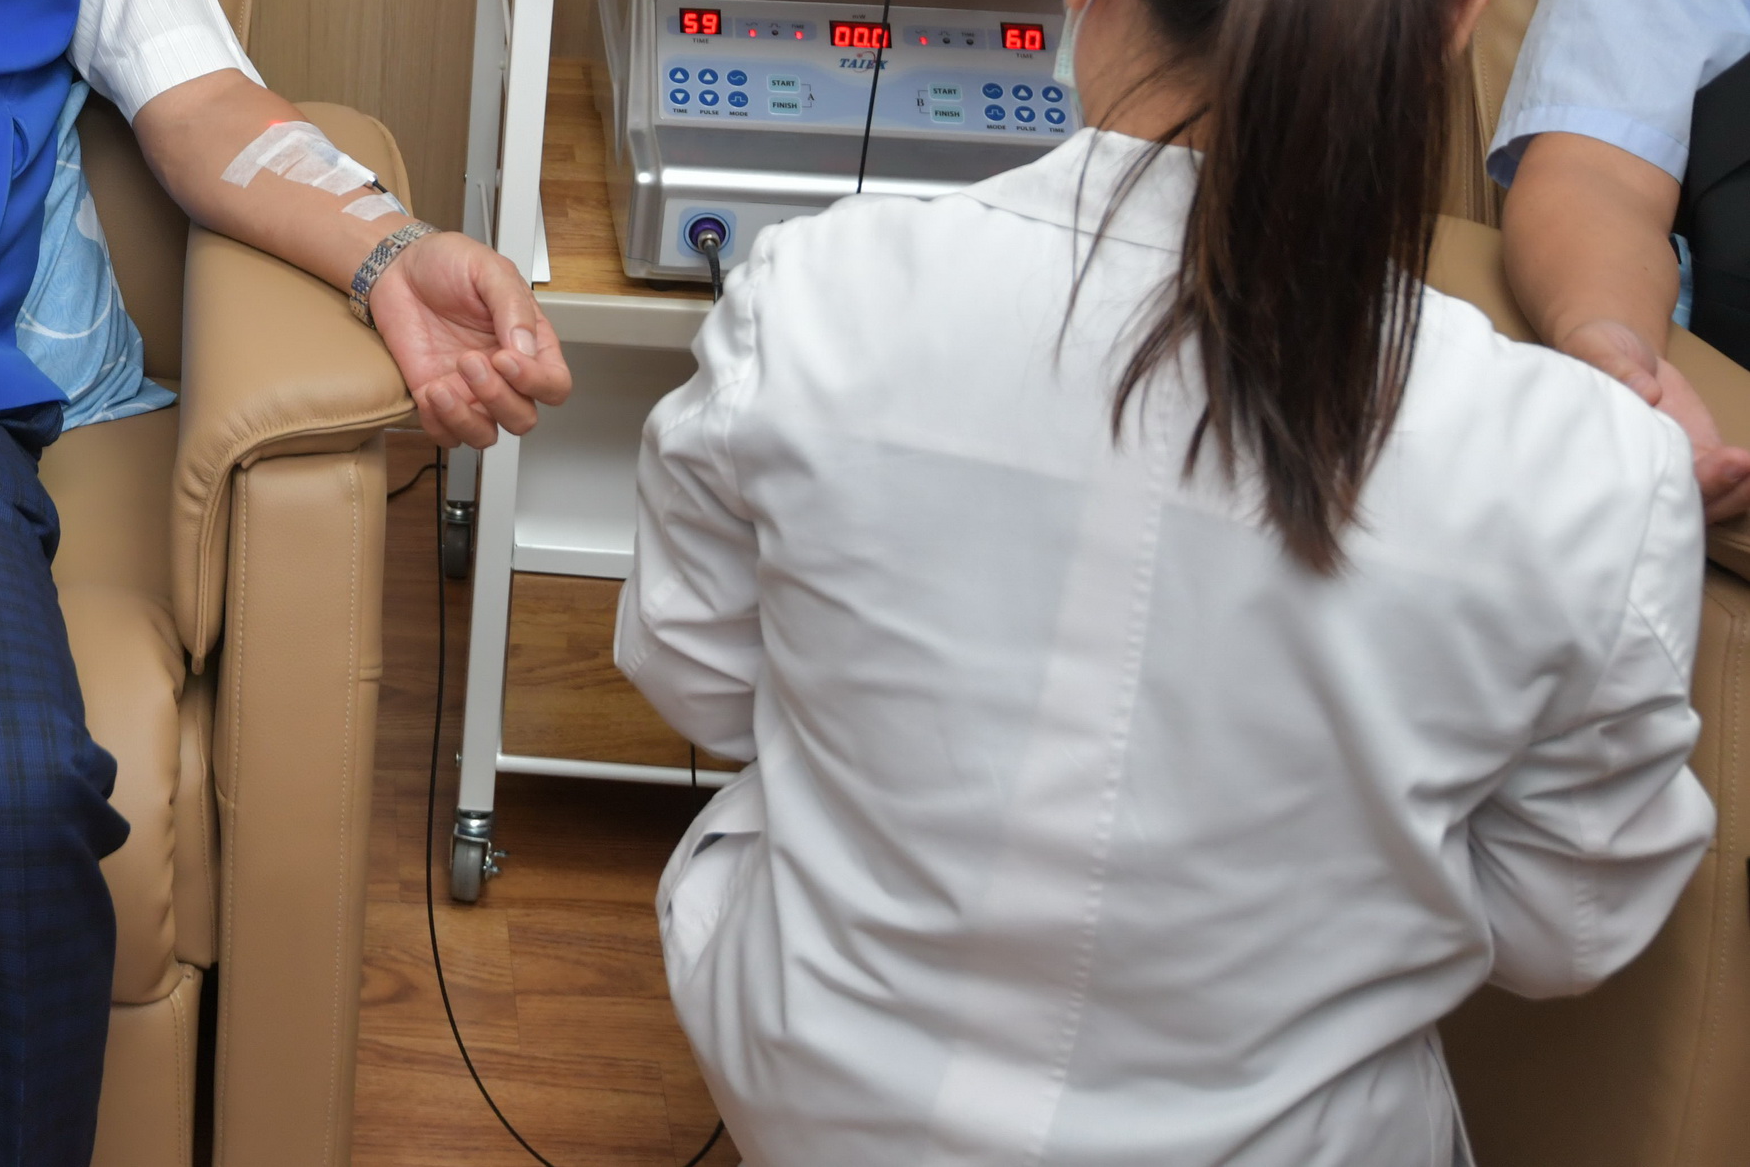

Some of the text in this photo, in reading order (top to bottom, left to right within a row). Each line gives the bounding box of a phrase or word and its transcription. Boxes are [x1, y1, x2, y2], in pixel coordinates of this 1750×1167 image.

[683, 13, 718, 34] 59
[1005, 29, 1042, 50] 60
[771, 79, 796, 87] START
[932, 87, 957, 95] START
[807, 93, 815, 101] A
[772, 101, 797, 110] FINISH
[916, 98, 925, 107] B
[934, 110, 960, 118] FINISH
